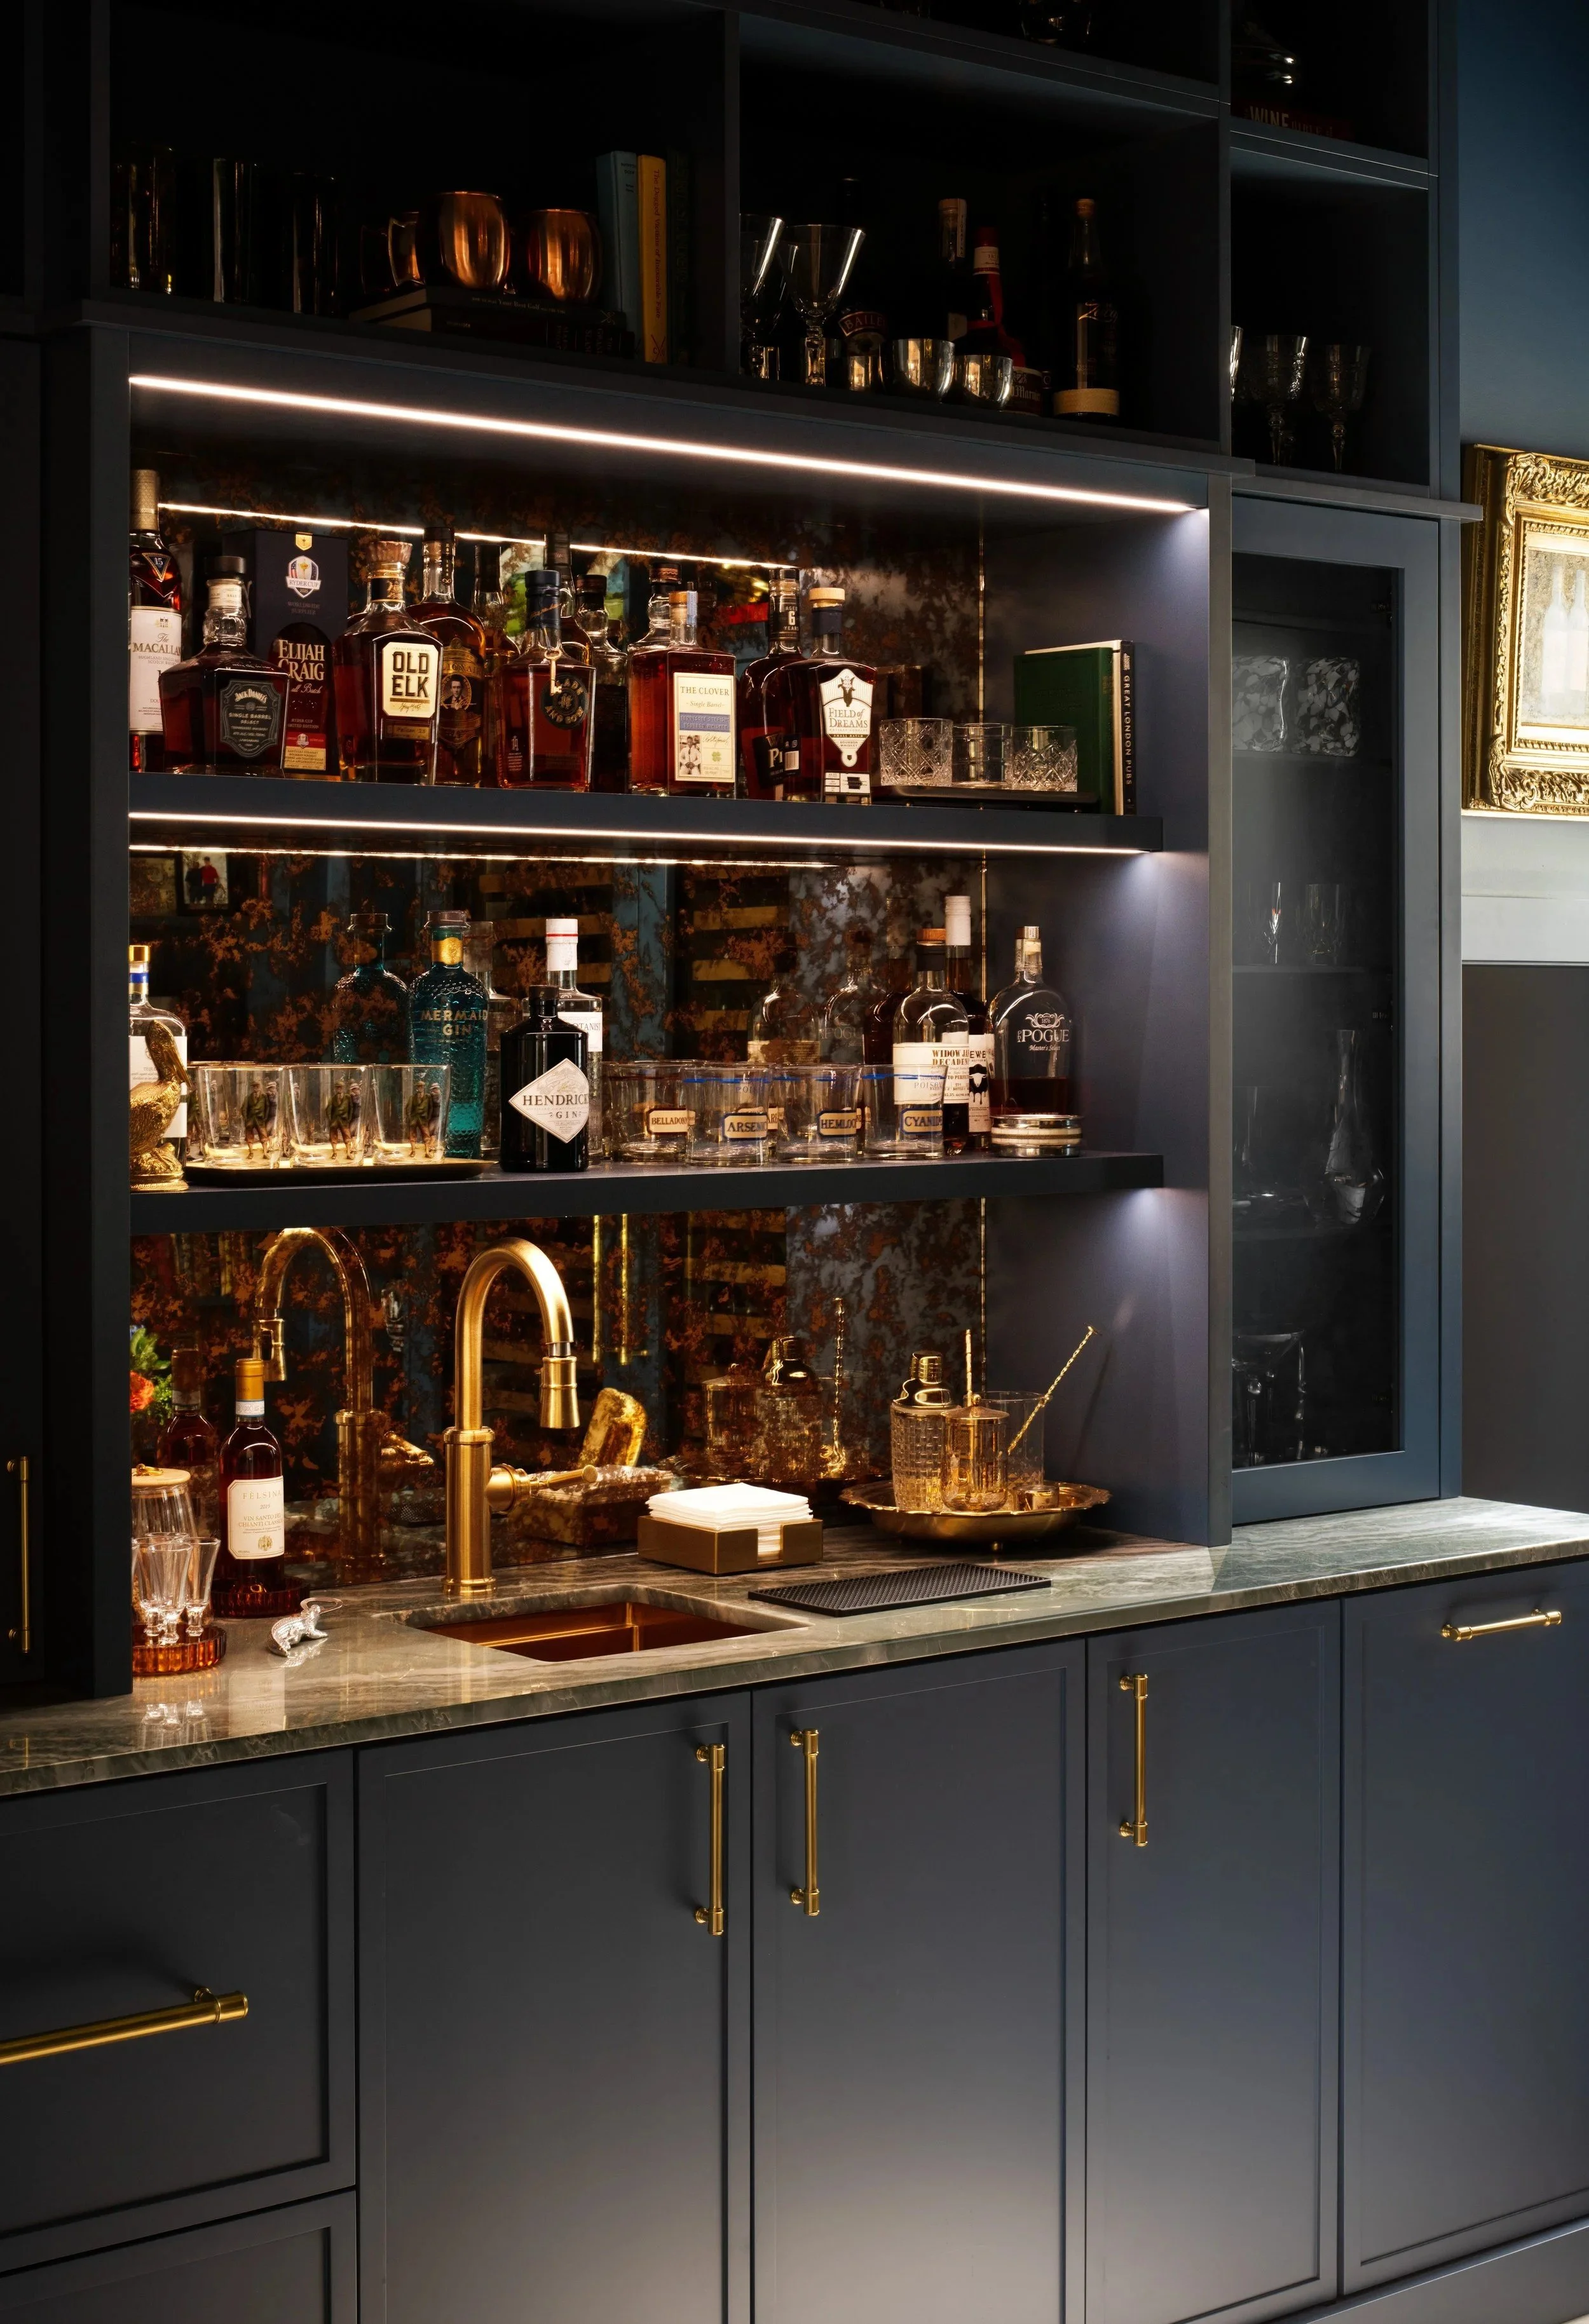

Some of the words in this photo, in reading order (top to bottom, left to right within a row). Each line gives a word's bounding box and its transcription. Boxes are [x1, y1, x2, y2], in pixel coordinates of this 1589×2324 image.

[498, 298, 512, 308] Your
[527, 302, 541, 311] Golf
[154, 557, 163, 566] 15
[788, 611, 796, 626] 6
[157, 633, 170, 642] The
[278, 639, 325, 664] ELIJAH
[392, 651, 430, 674] OLD
[277, 658, 325, 683] CRAIG
[301, 683, 323, 695] Batch
[391, 675, 431, 698] ELK
[680, 686, 697, 695] THE
[699, 686, 730, 697] CLOVER
[690, 700, 706, 709] Single
[544, 705, 564, 724] AND
[829, 707, 856, 719] FIELD
[856, 709, 866, 721] of
[829, 717, 868, 729] DREAMS
[421, 1009, 488, 1021] MERMAID
[442, 1023, 472, 1036] GIN
[573, 1023, 601, 1031] OTANIST
[1021, 1029, 1070, 1043] POGUE
[932, 1049, 962, 1058] WIDOW
[556, 1111, 578, 1119] GIN
[651, 1117, 689, 1125] BELLADONN
[727, 1122, 767, 1132] ARSENIC
[821, 1118, 857, 1129] HEMLOC
